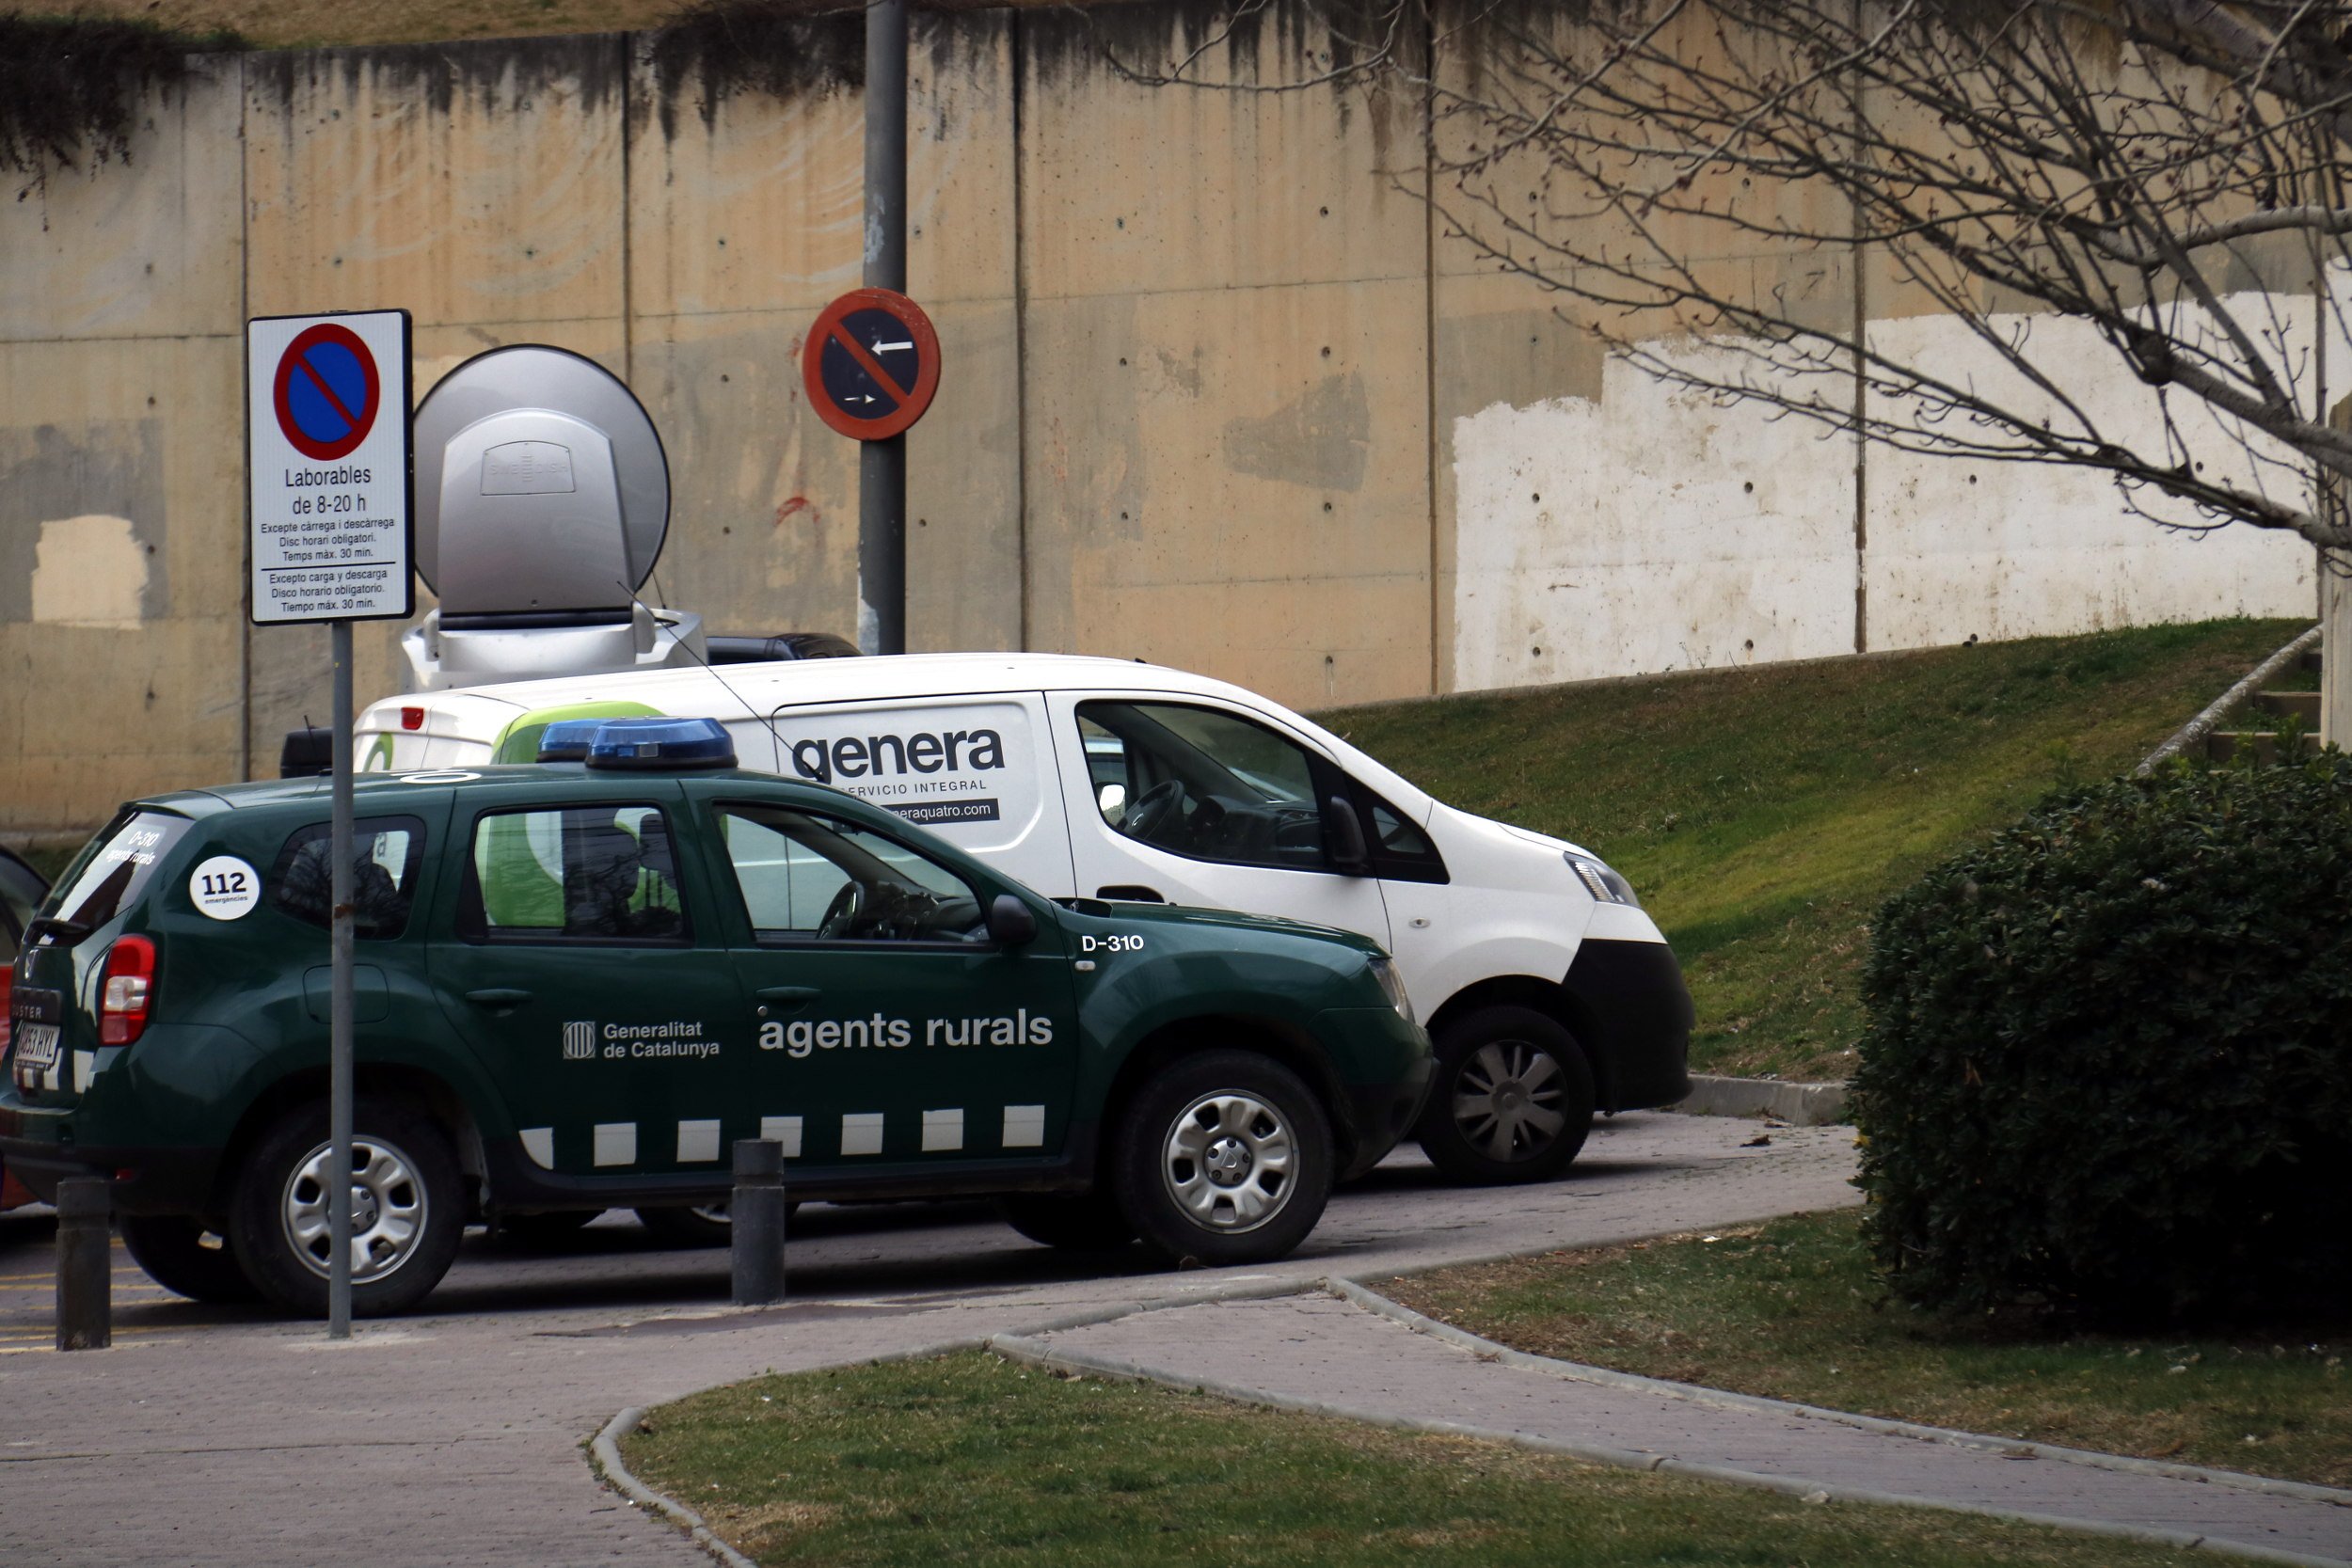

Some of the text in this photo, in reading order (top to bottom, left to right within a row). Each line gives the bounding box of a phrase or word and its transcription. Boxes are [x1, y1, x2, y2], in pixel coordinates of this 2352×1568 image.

[285, 466, 371, 487] Laborables
[293, 493, 366, 515] de 8-20 h
[261, 517, 394, 534] Excepte càrrega i descàrrega
[279, 532, 376, 547] Disc horari obligatori.
[283, 550, 312, 562] Temps
[315, 549, 338, 560] màx.
[340, 548, 352, 559] 30
[269, 569, 388, 585] Excepto carga y descarga
[271, 583, 385, 598] Disco horario obligatorio.
[281, 601, 314, 613] Tiempo
[317, 599, 339, 610] máx.
[342, 599, 354, 610] 30
[792, 729, 1006, 784] genera
[914, 780, 987, 794] INTEGRAL
[127, 831, 160, 847] D-310
[201, 872, 246, 895] 112
[1081, 935, 1144, 952] D-310
[603, 1022, 702, 1039] Generalitat
[759, 1008, 1053, 1058] agents rurals
[35, 1029, 54, 1057] HYL
[603, 1040, 720, 1059] de Catalunya
